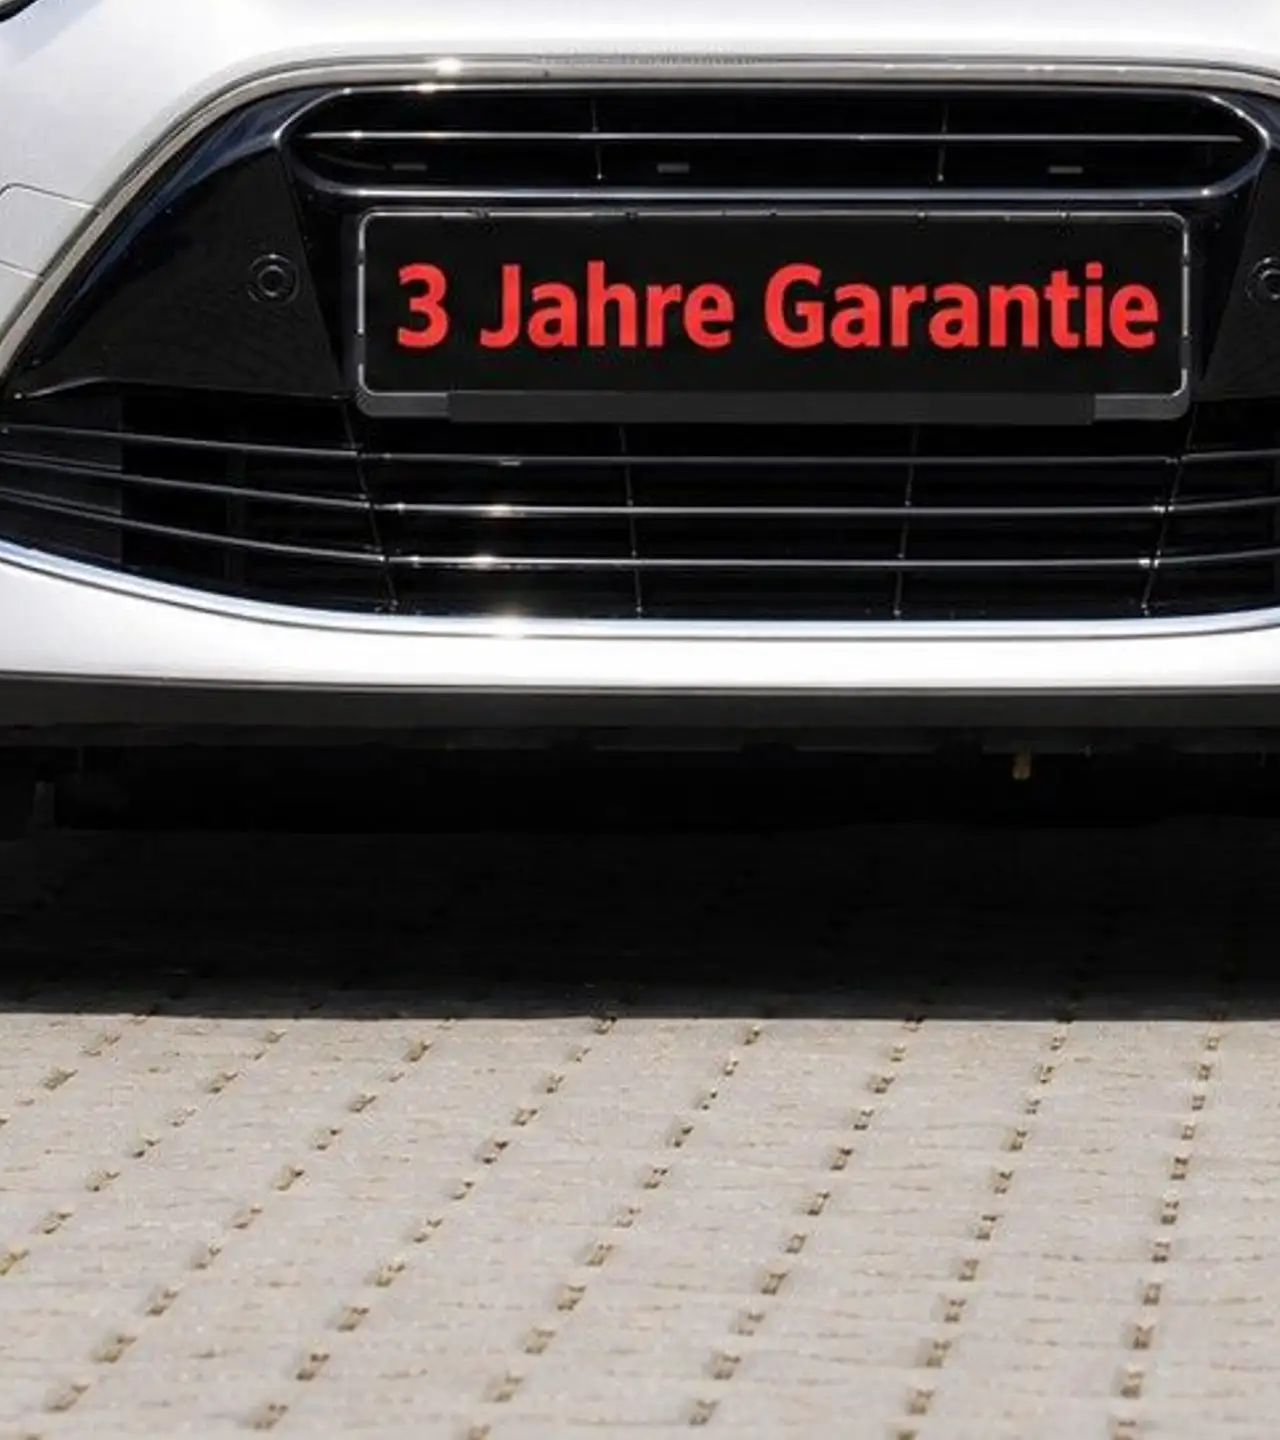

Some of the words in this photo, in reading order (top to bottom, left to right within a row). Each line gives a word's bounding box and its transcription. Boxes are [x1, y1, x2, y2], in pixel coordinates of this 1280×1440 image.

[396, 263, 449, 350] 3
[479, 260, 735, 350] Jahre
[763, 262, 1161, 350] Garantie
